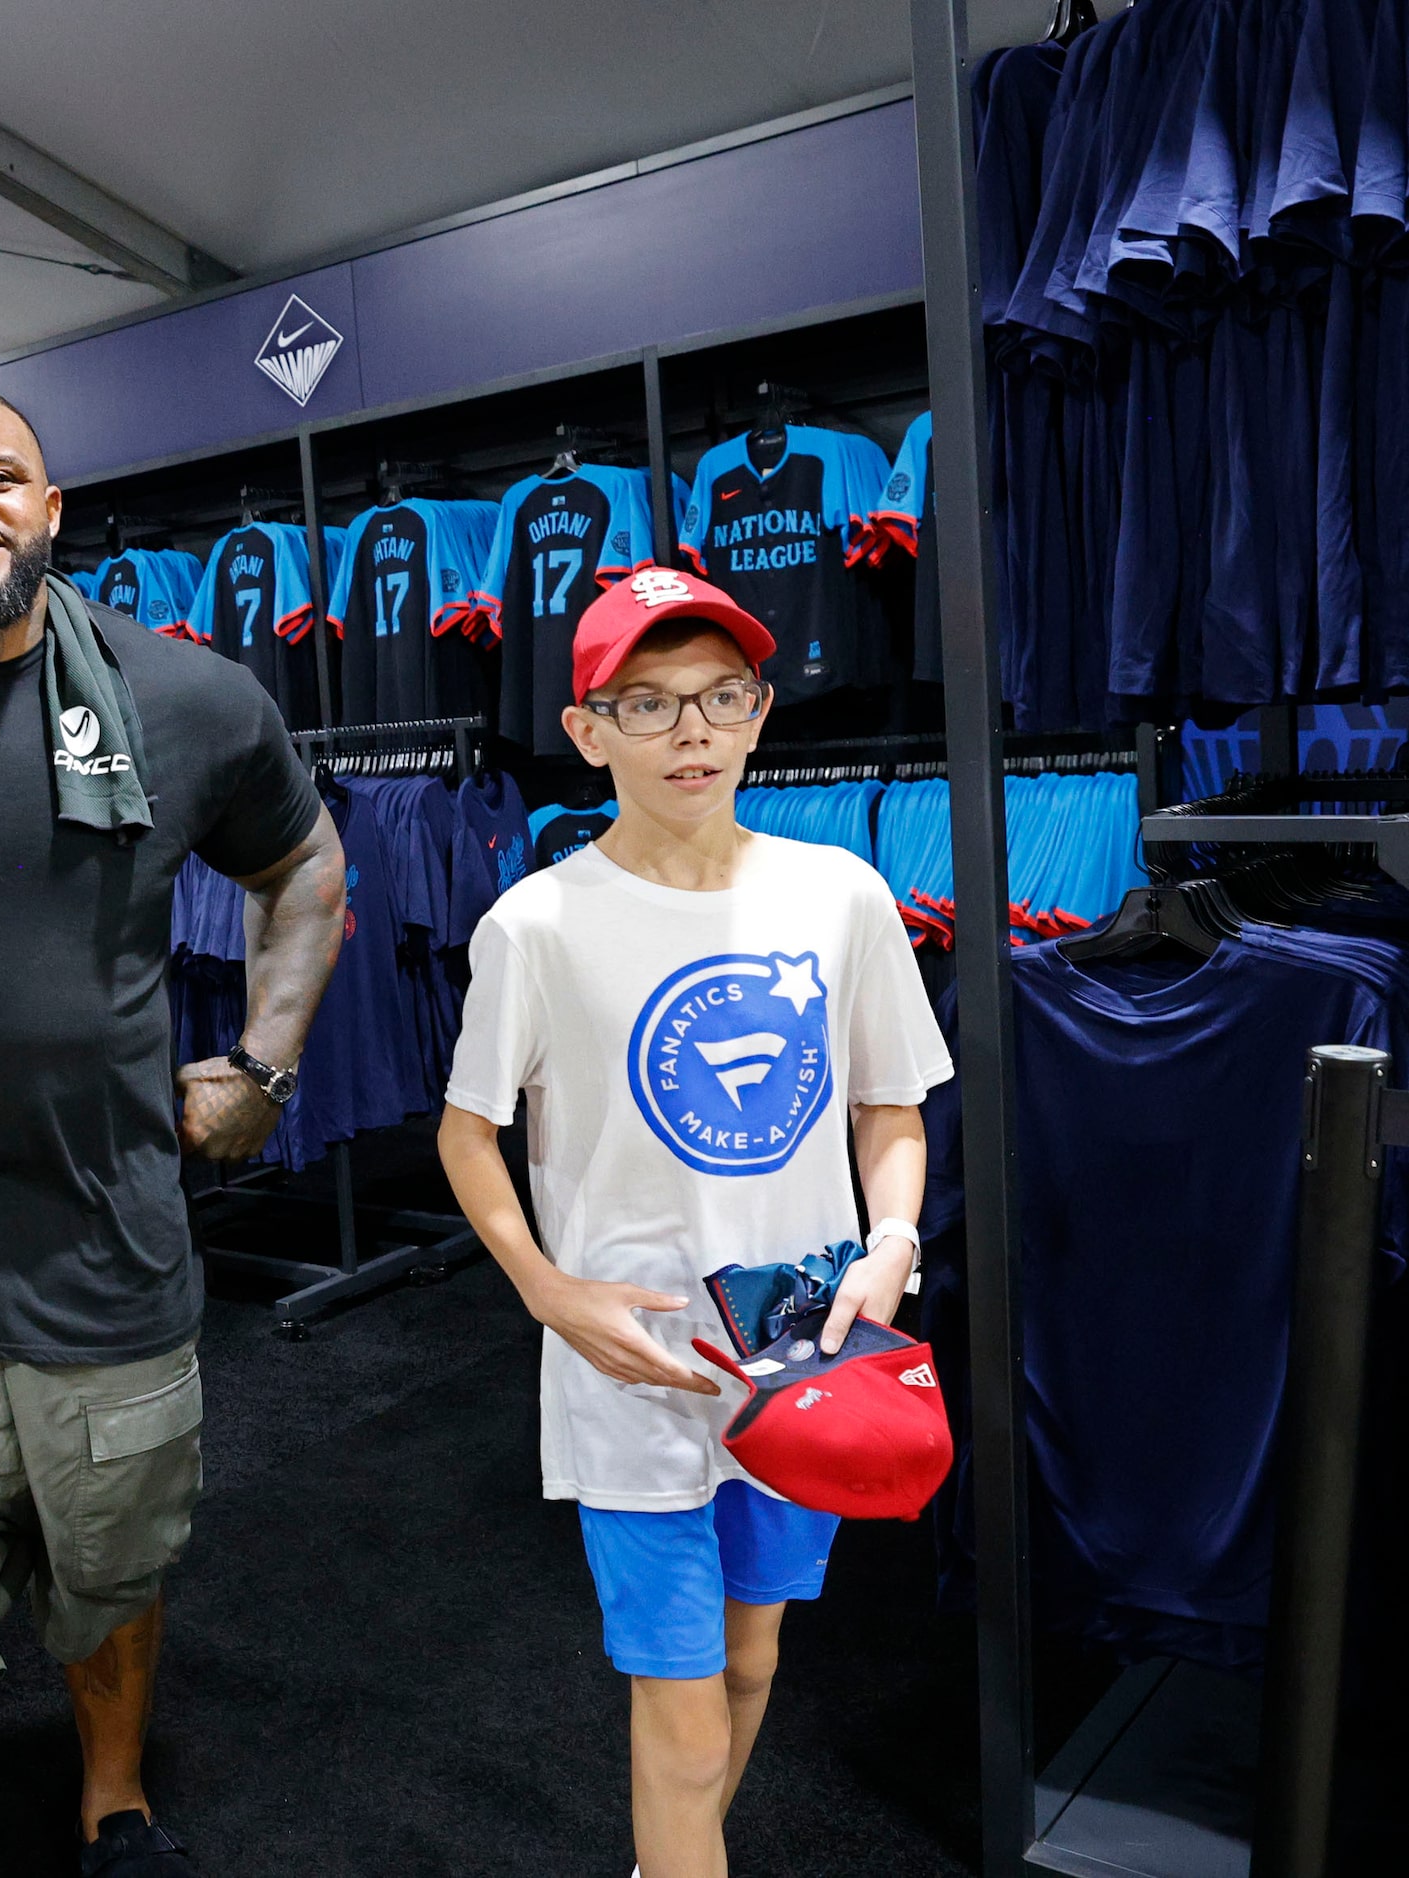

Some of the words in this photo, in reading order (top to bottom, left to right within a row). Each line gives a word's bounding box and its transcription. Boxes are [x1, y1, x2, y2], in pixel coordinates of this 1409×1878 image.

[373, 536, 415, 567] HTANI
[529, 511, 592, 544] OHTANI
[730, 540, 817, 571] LEAGUE
[375, 571, 410, 637] 17
[533, 548, 583, 618] 17
[659, 984, 743, 1091] FANATICS
